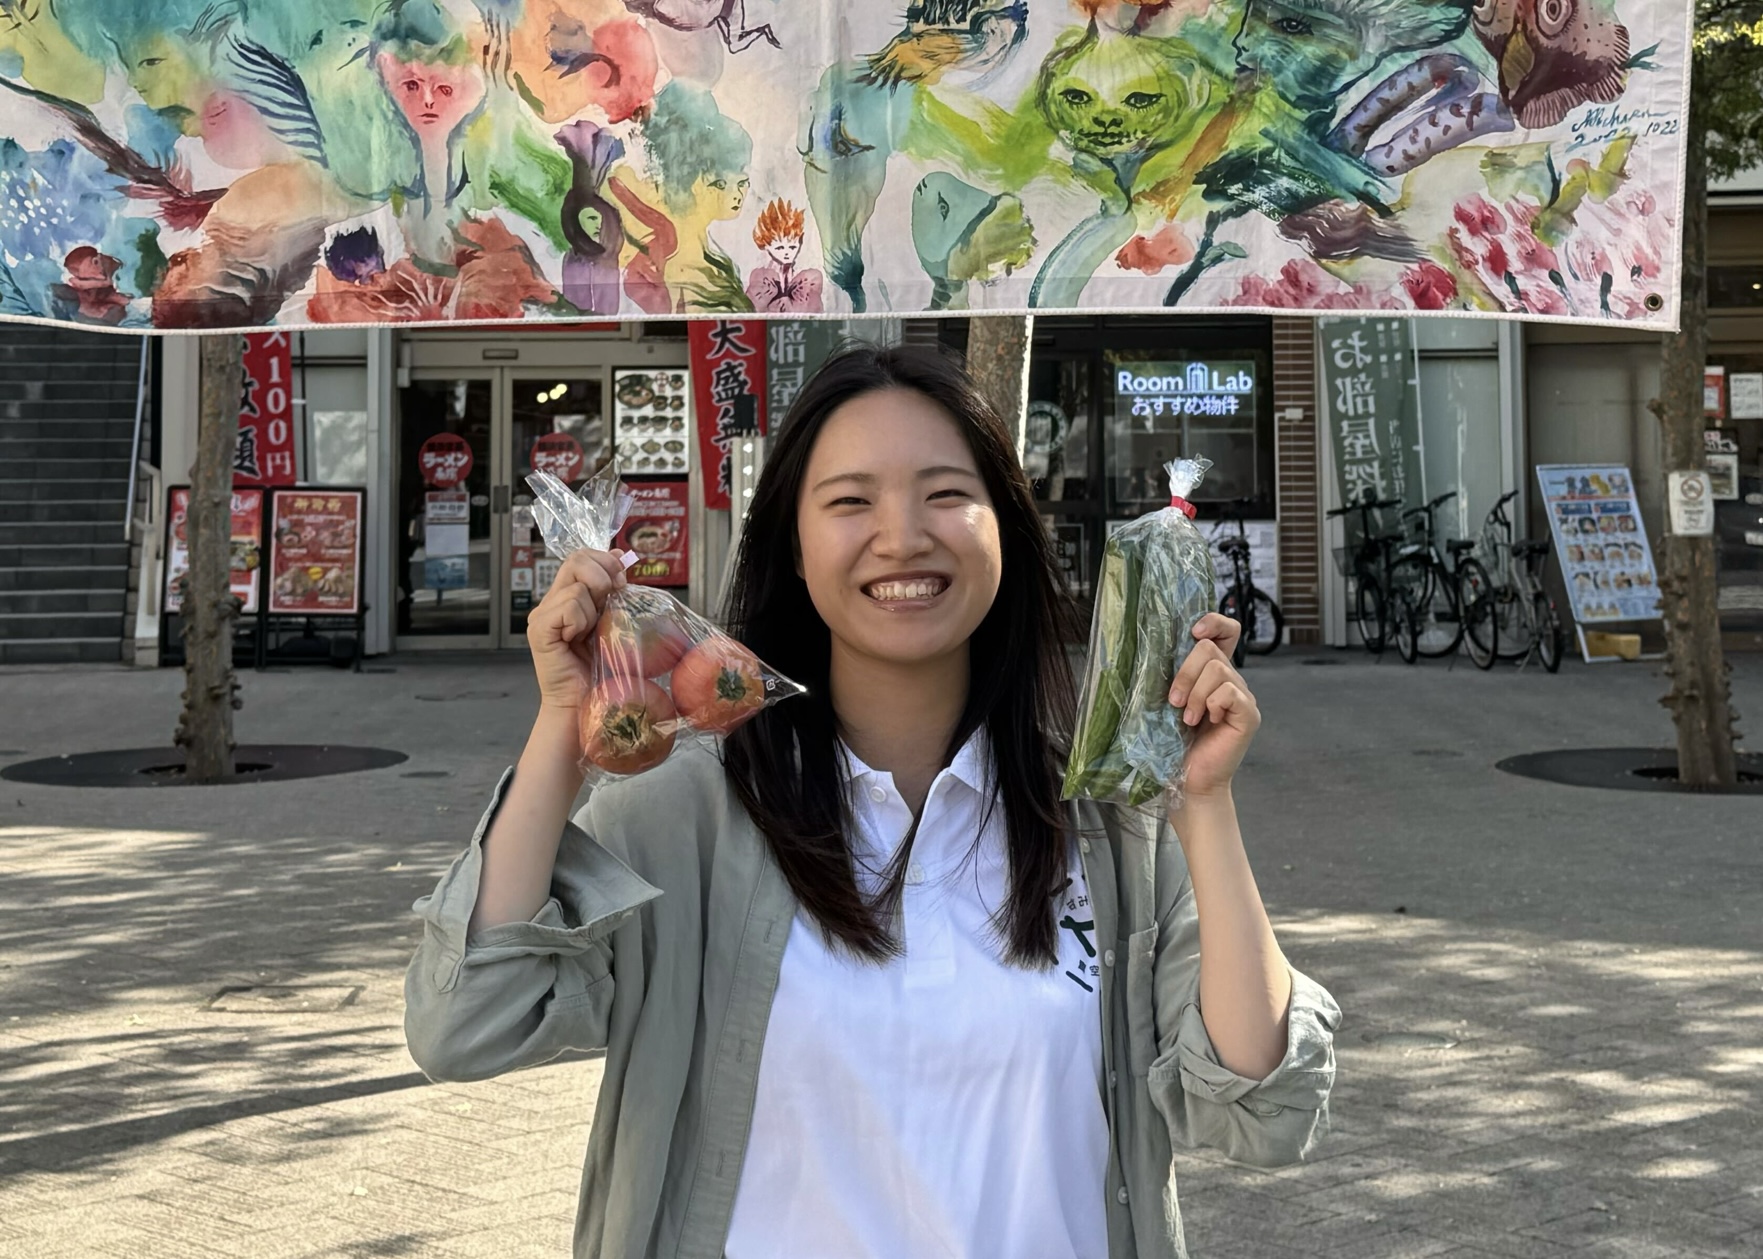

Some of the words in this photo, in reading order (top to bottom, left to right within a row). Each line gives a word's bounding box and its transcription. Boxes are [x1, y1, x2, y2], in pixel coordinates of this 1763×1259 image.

[1118, 371, 1183, 392] Room
[1212, 371, 1253, 392] Lab
[1131, 395, 1240, 416] おすすめ物件
[422, 451, 469, 469] ラーメン
[534, 451, 580, 468] ラーメン
